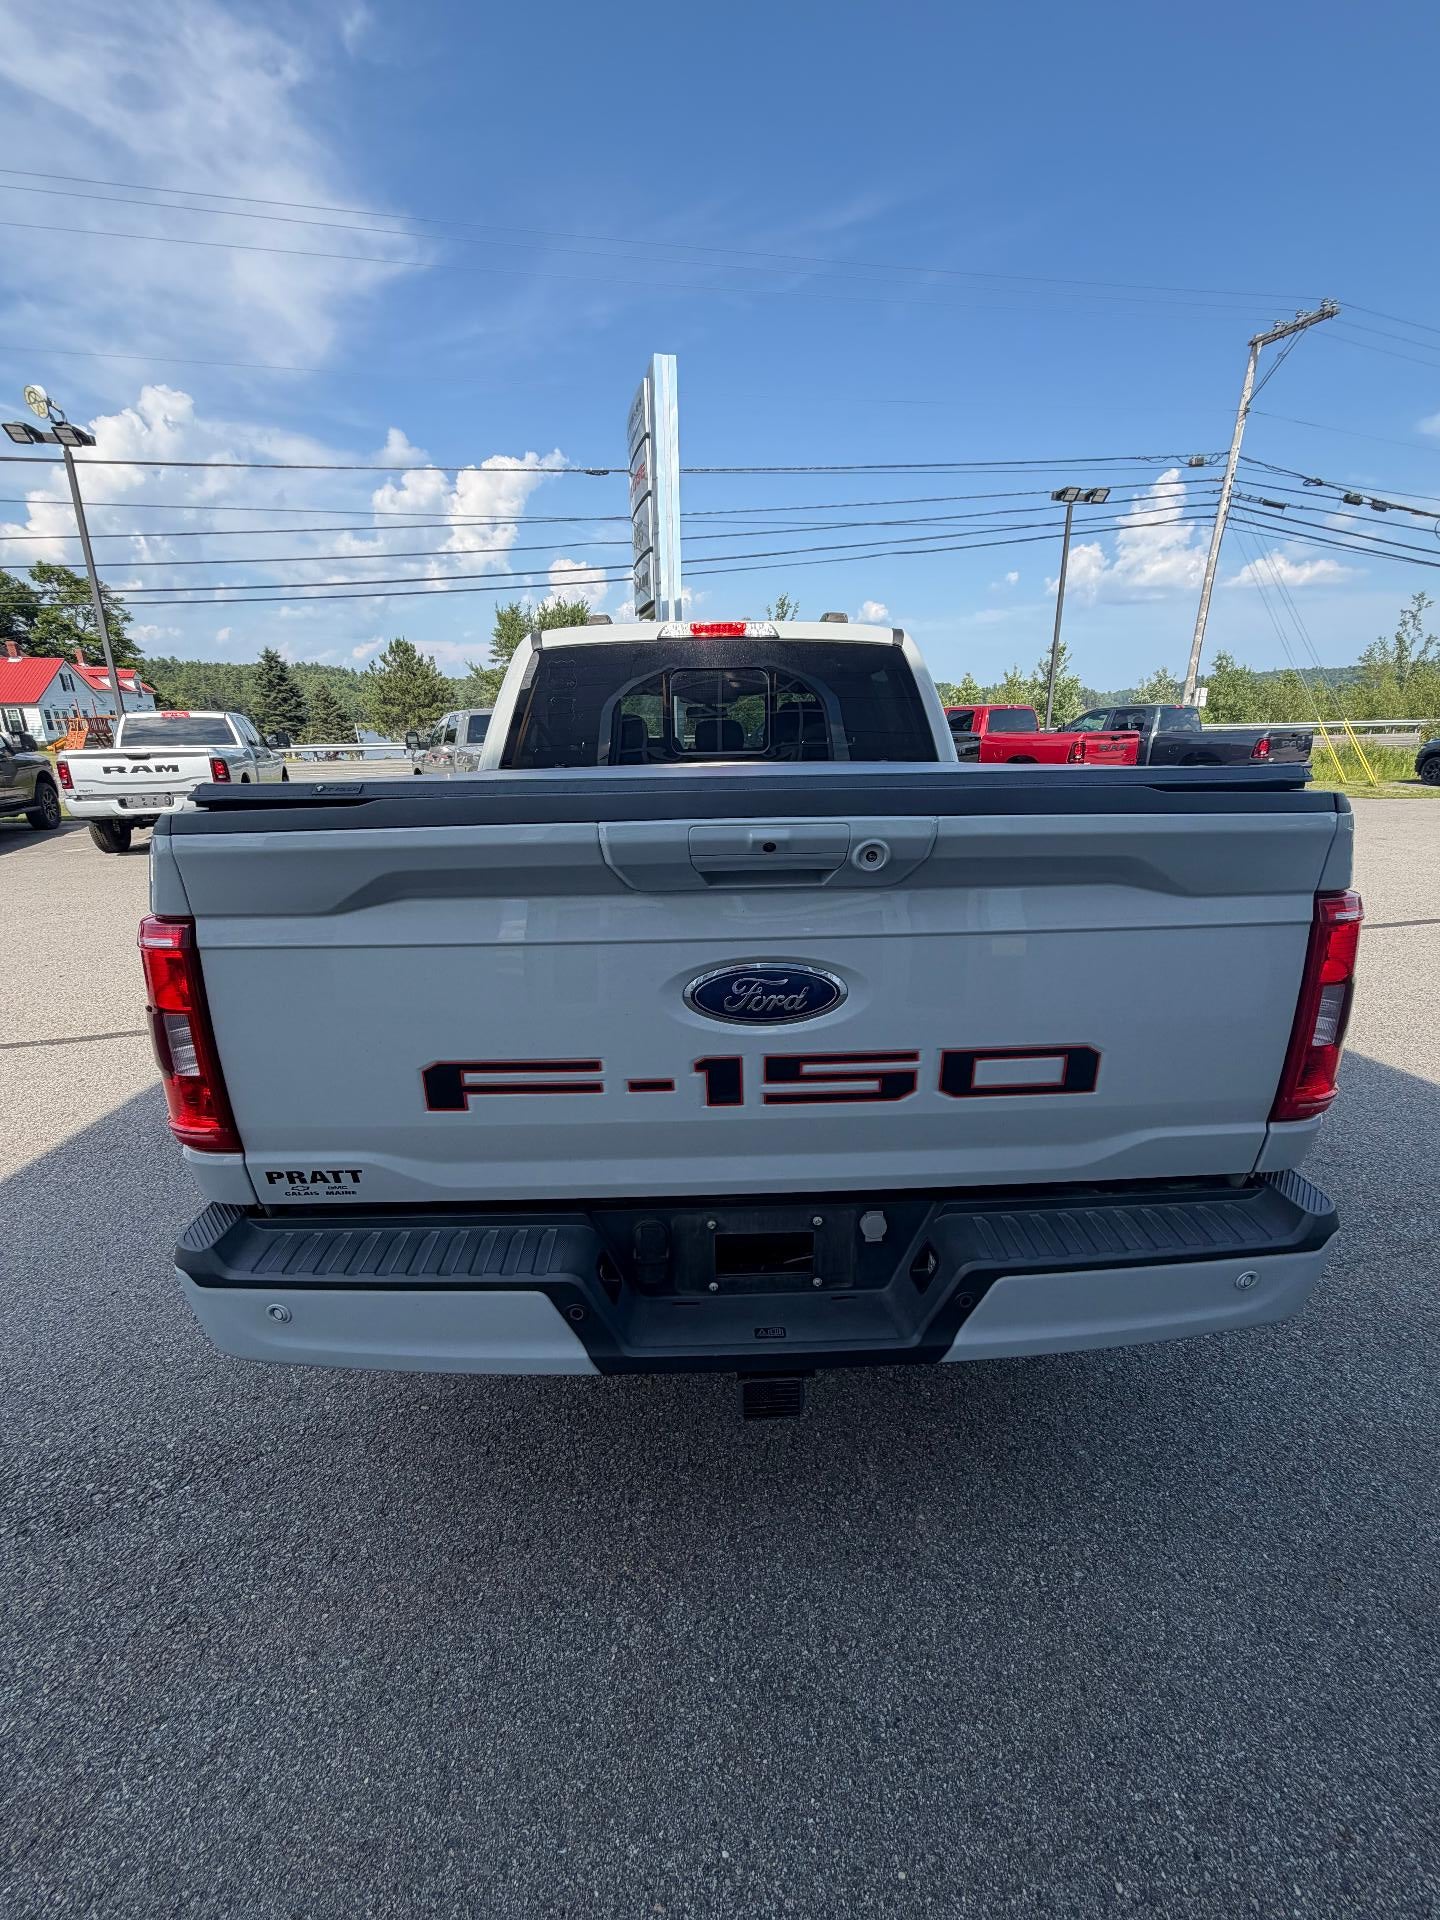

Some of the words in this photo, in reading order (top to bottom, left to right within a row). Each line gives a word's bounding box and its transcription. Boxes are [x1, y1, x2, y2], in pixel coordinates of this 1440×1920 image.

[102, 764, 180, 775] RAM
[724, 977, 810, 1012] Ford
[421, 1045, 1101, 1112] F-150
[265, 1169, 363, 1185] PRATT
